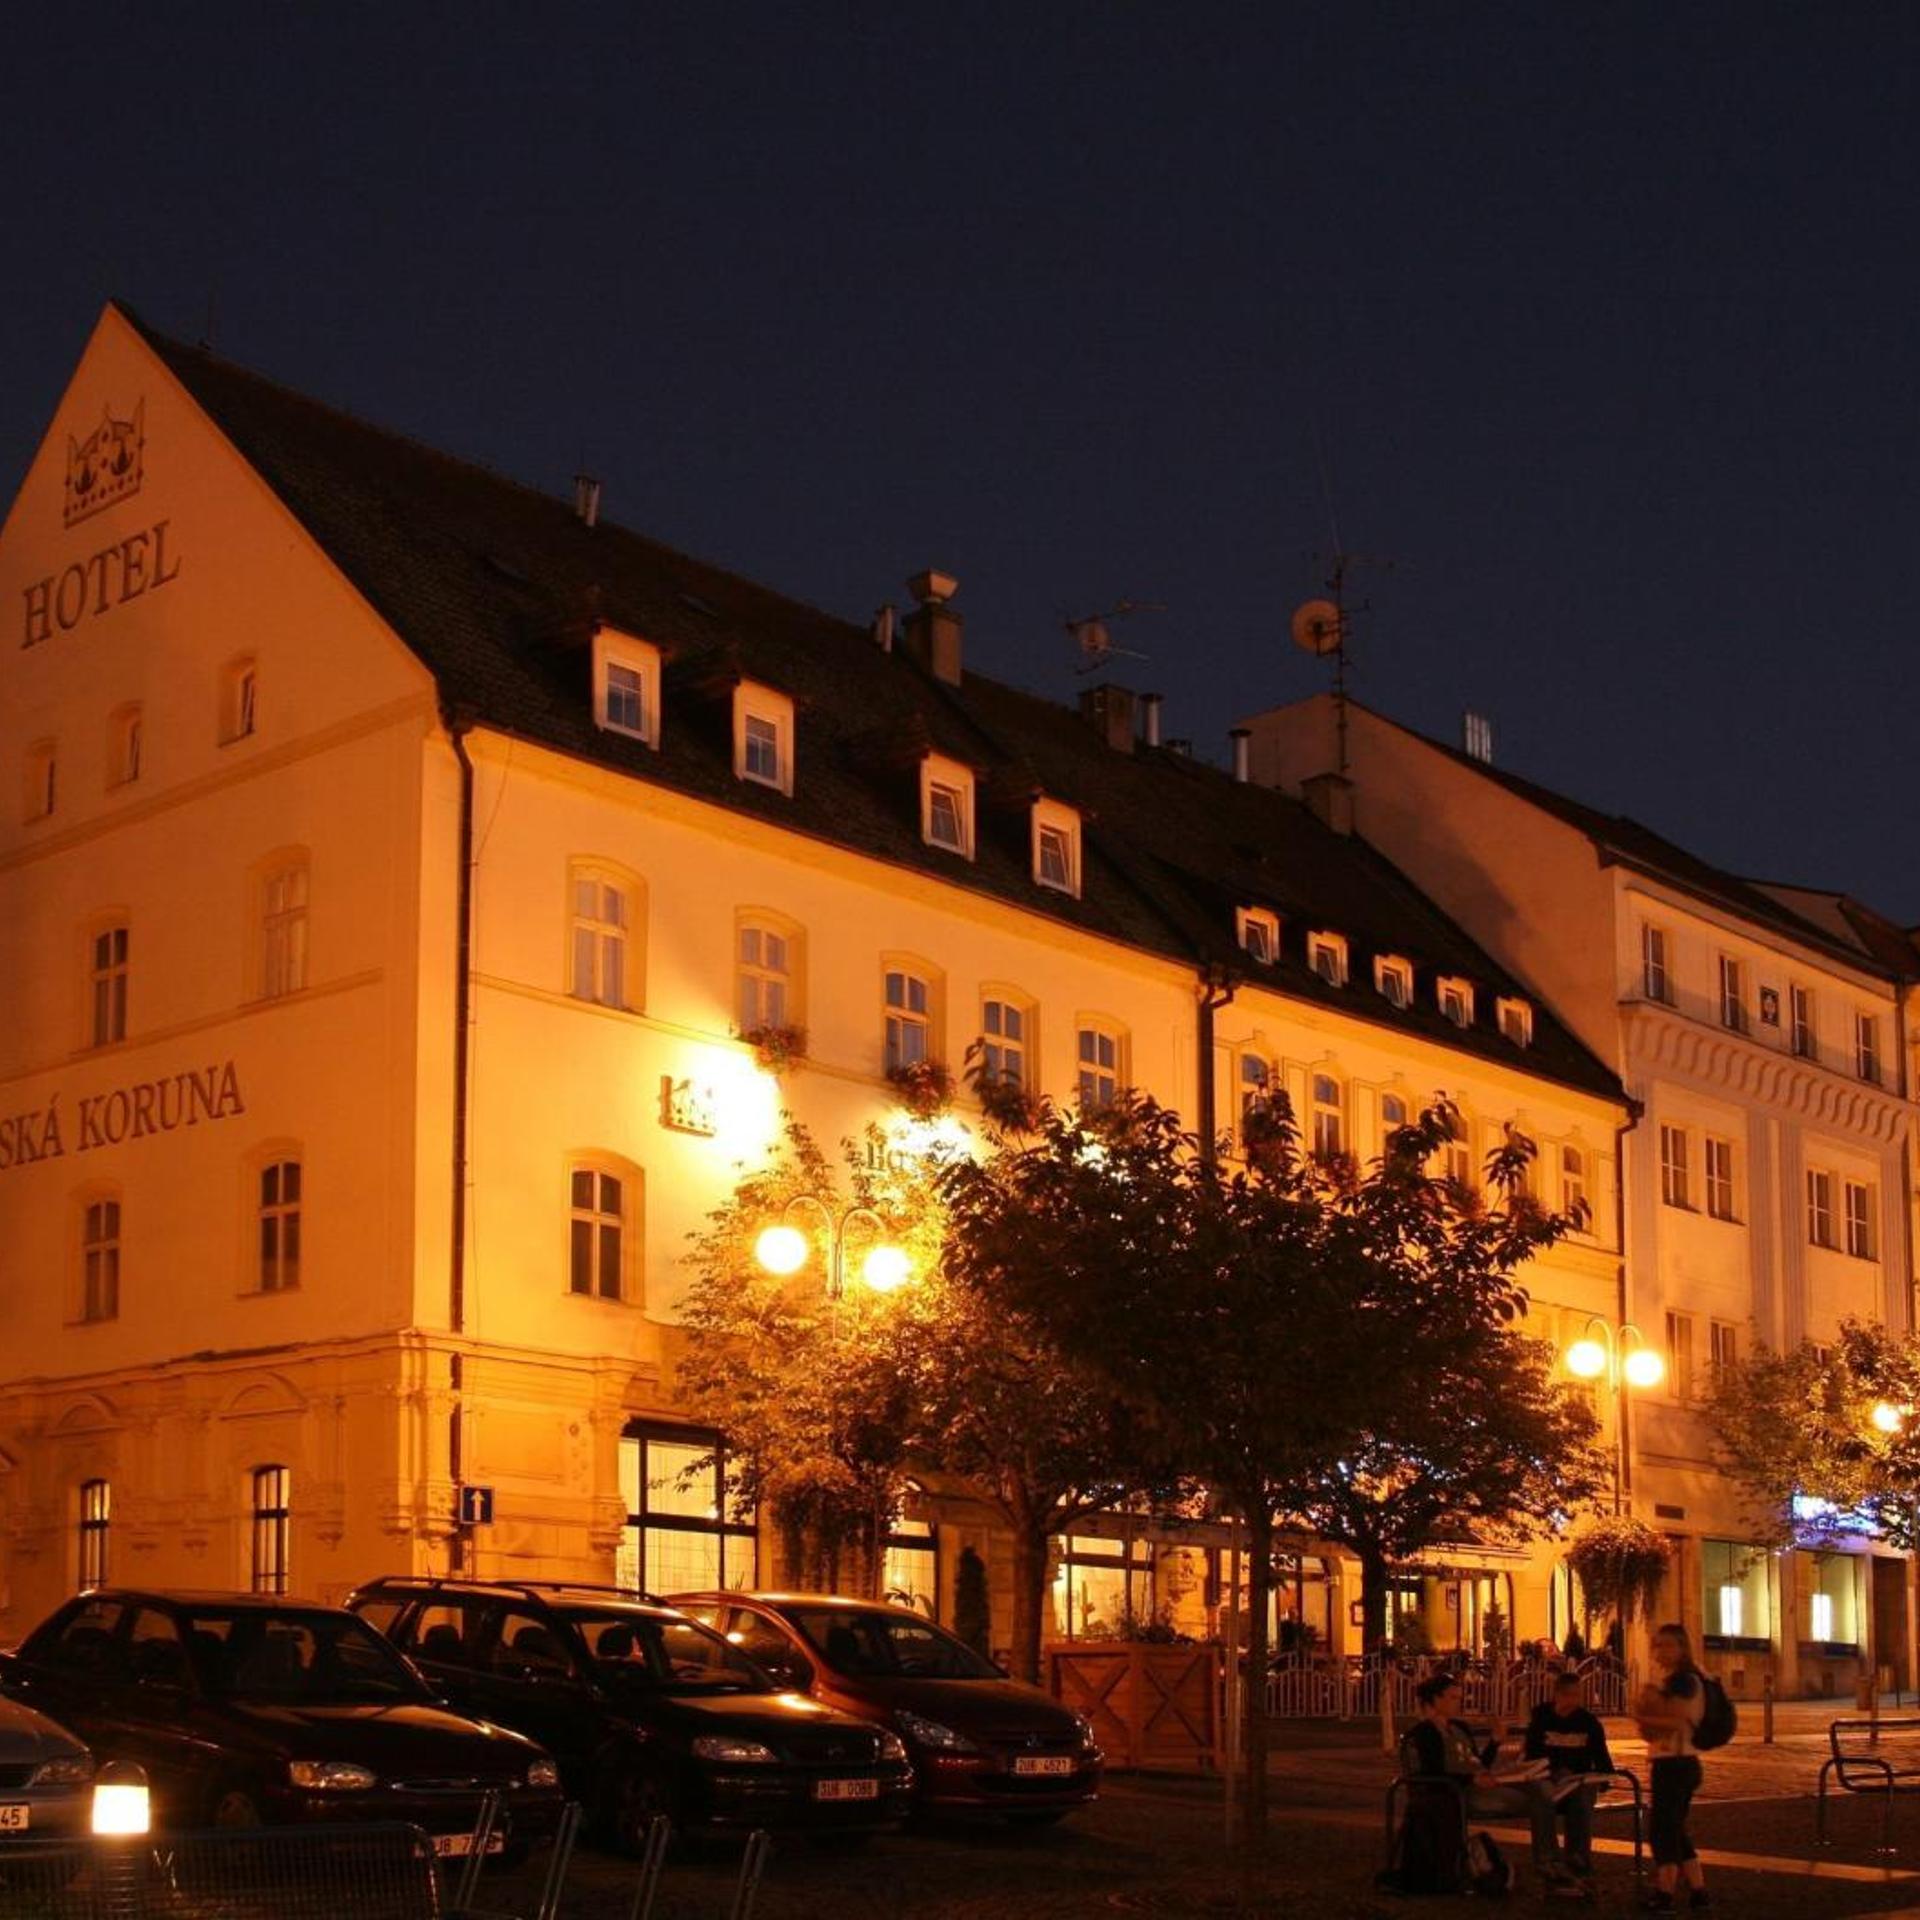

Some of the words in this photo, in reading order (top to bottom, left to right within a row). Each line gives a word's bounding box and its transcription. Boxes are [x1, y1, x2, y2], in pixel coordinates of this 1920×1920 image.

[21, 519, 182, 650] HOTEL
[0, 1091, 65, 1170] SKÁ
[76, 1060, 246, 1152] KORUNA
